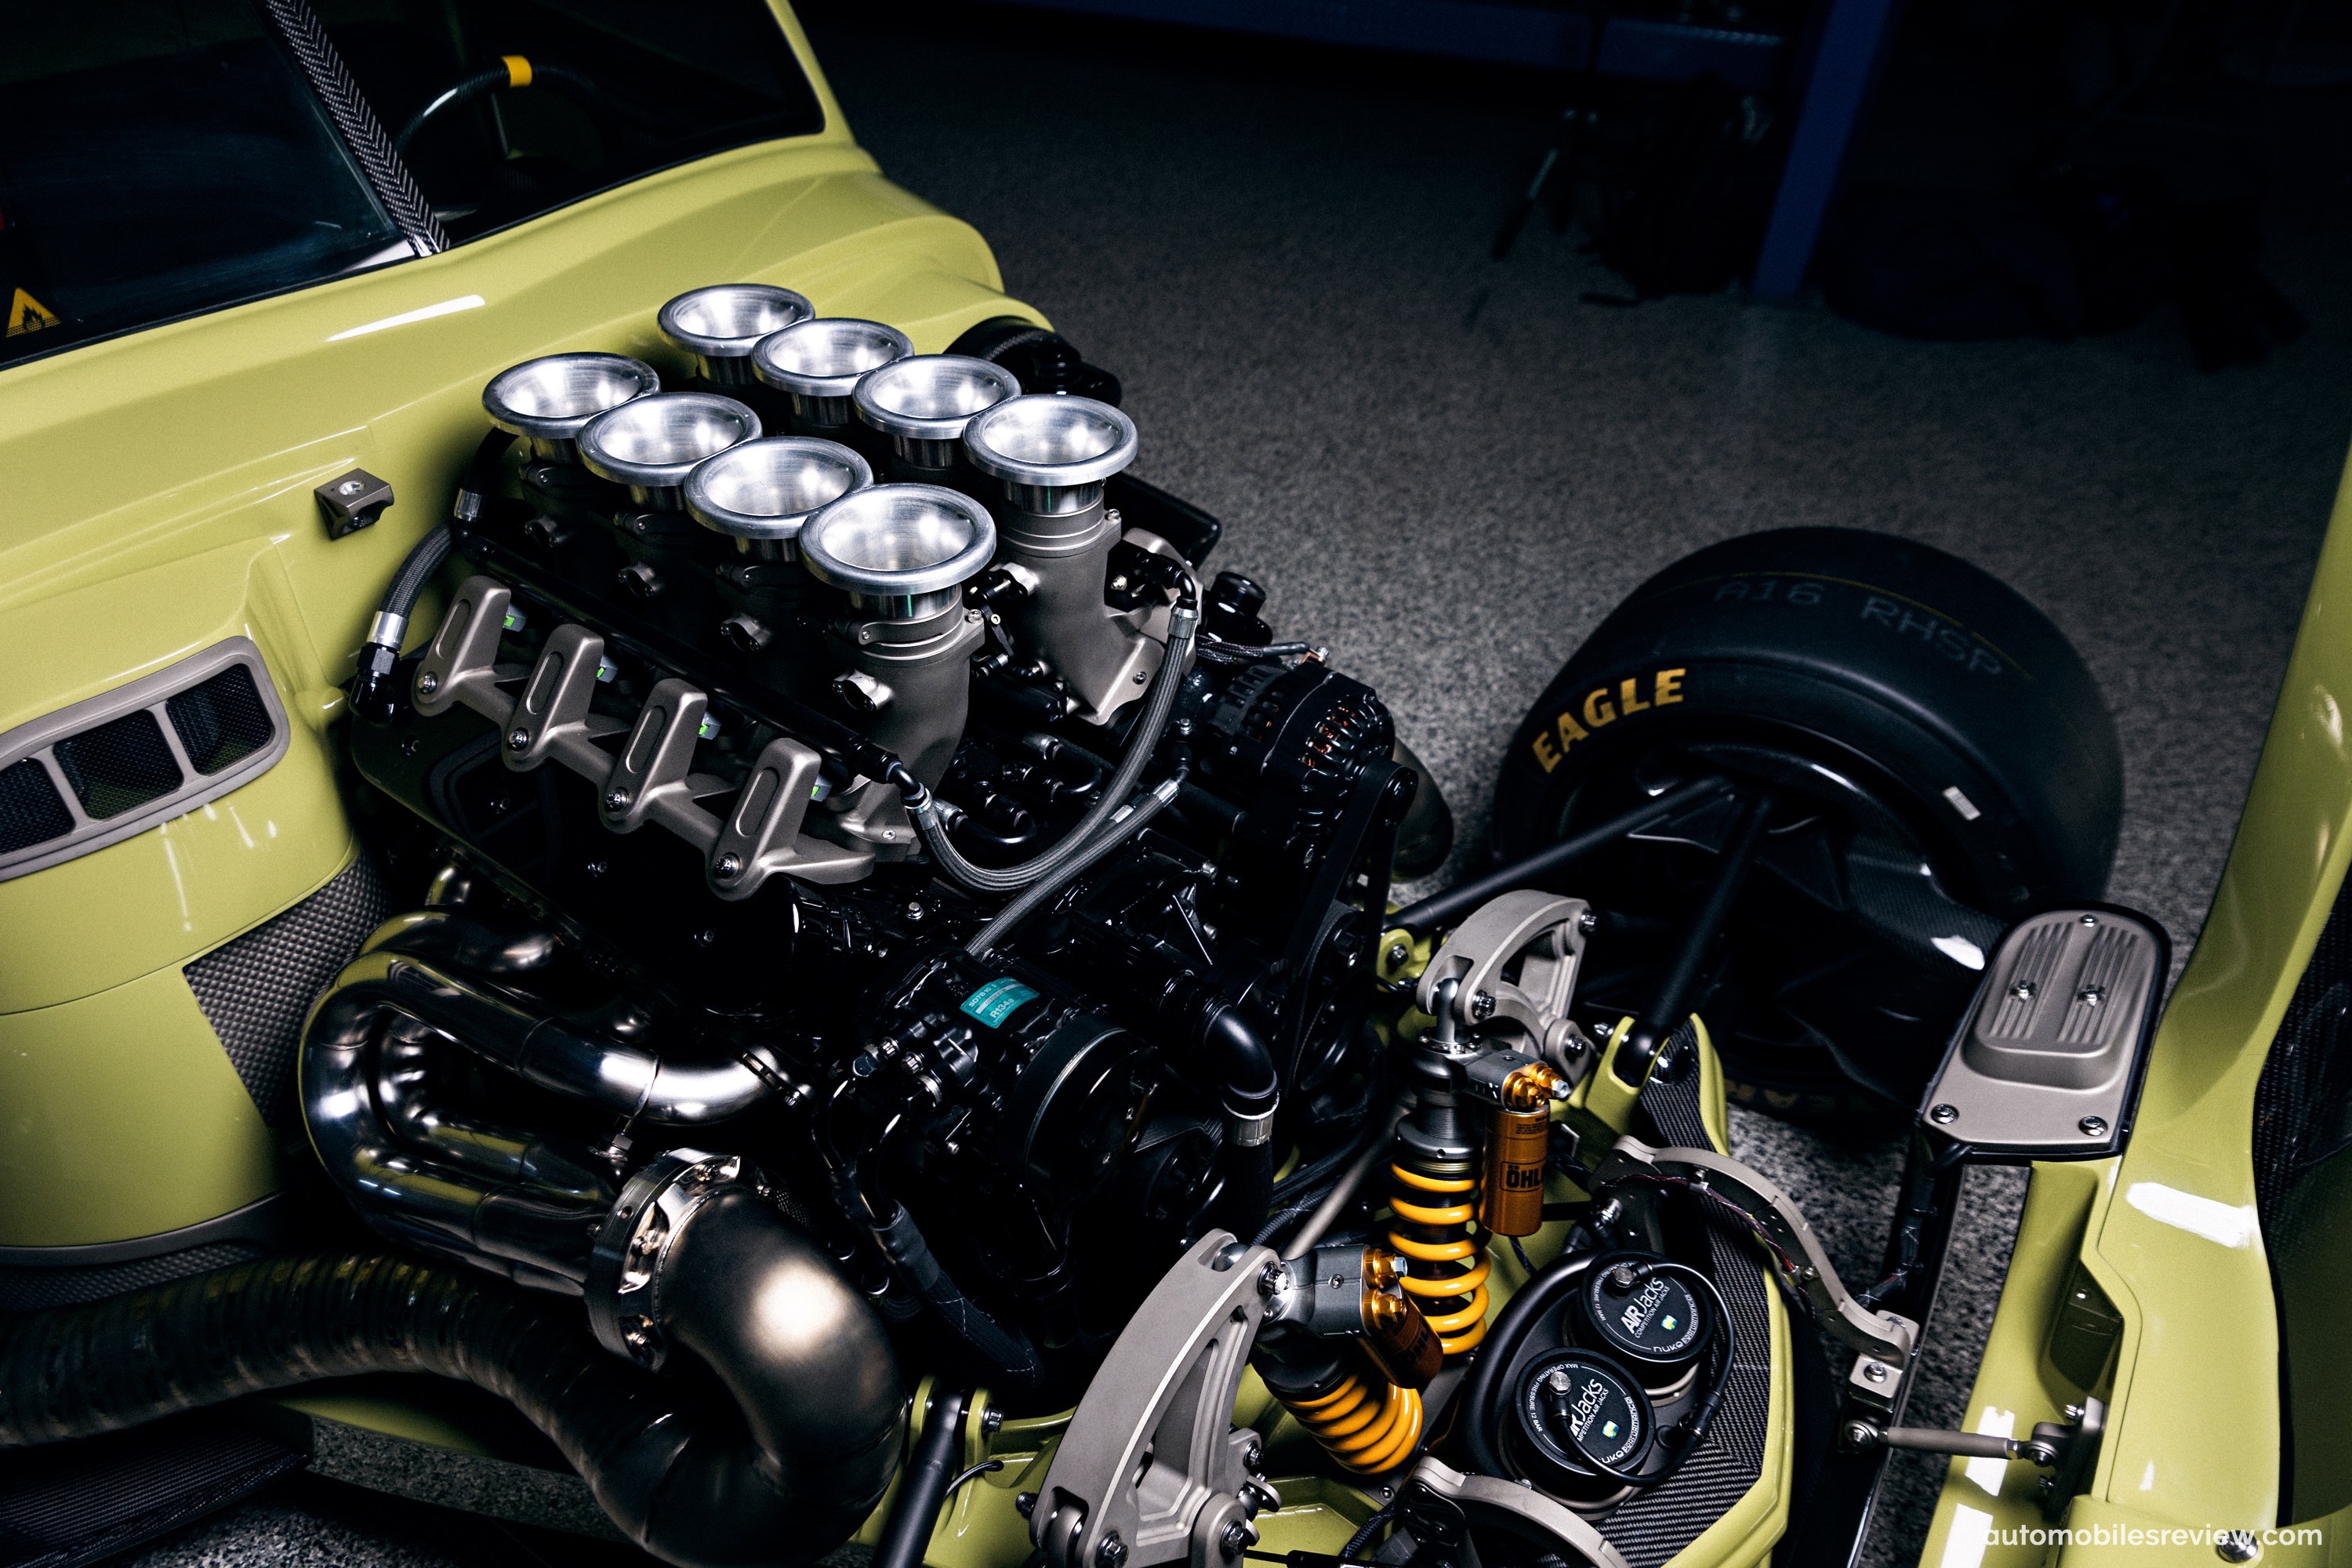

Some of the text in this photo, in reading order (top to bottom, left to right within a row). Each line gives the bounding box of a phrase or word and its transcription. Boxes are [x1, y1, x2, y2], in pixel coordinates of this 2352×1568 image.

[1531, 667, 1686, 774] EAGLE
[989, 998, 1015, 1018] R134a
[1635, 1306, 1657, 1338] COMPETITION
[1659, 1285, 1670, 1301] JACKS
[1537, 1364, 1565, 1383] OPERATING
[1529, 1381, 1541, 1411] PRESSURE
[1533, 1419, 1544, 1432] BAR
[1577, 1388, 1610, 1443] MPETITION AIR JACKS
[1599, 1450, 1625, 1464] uke
